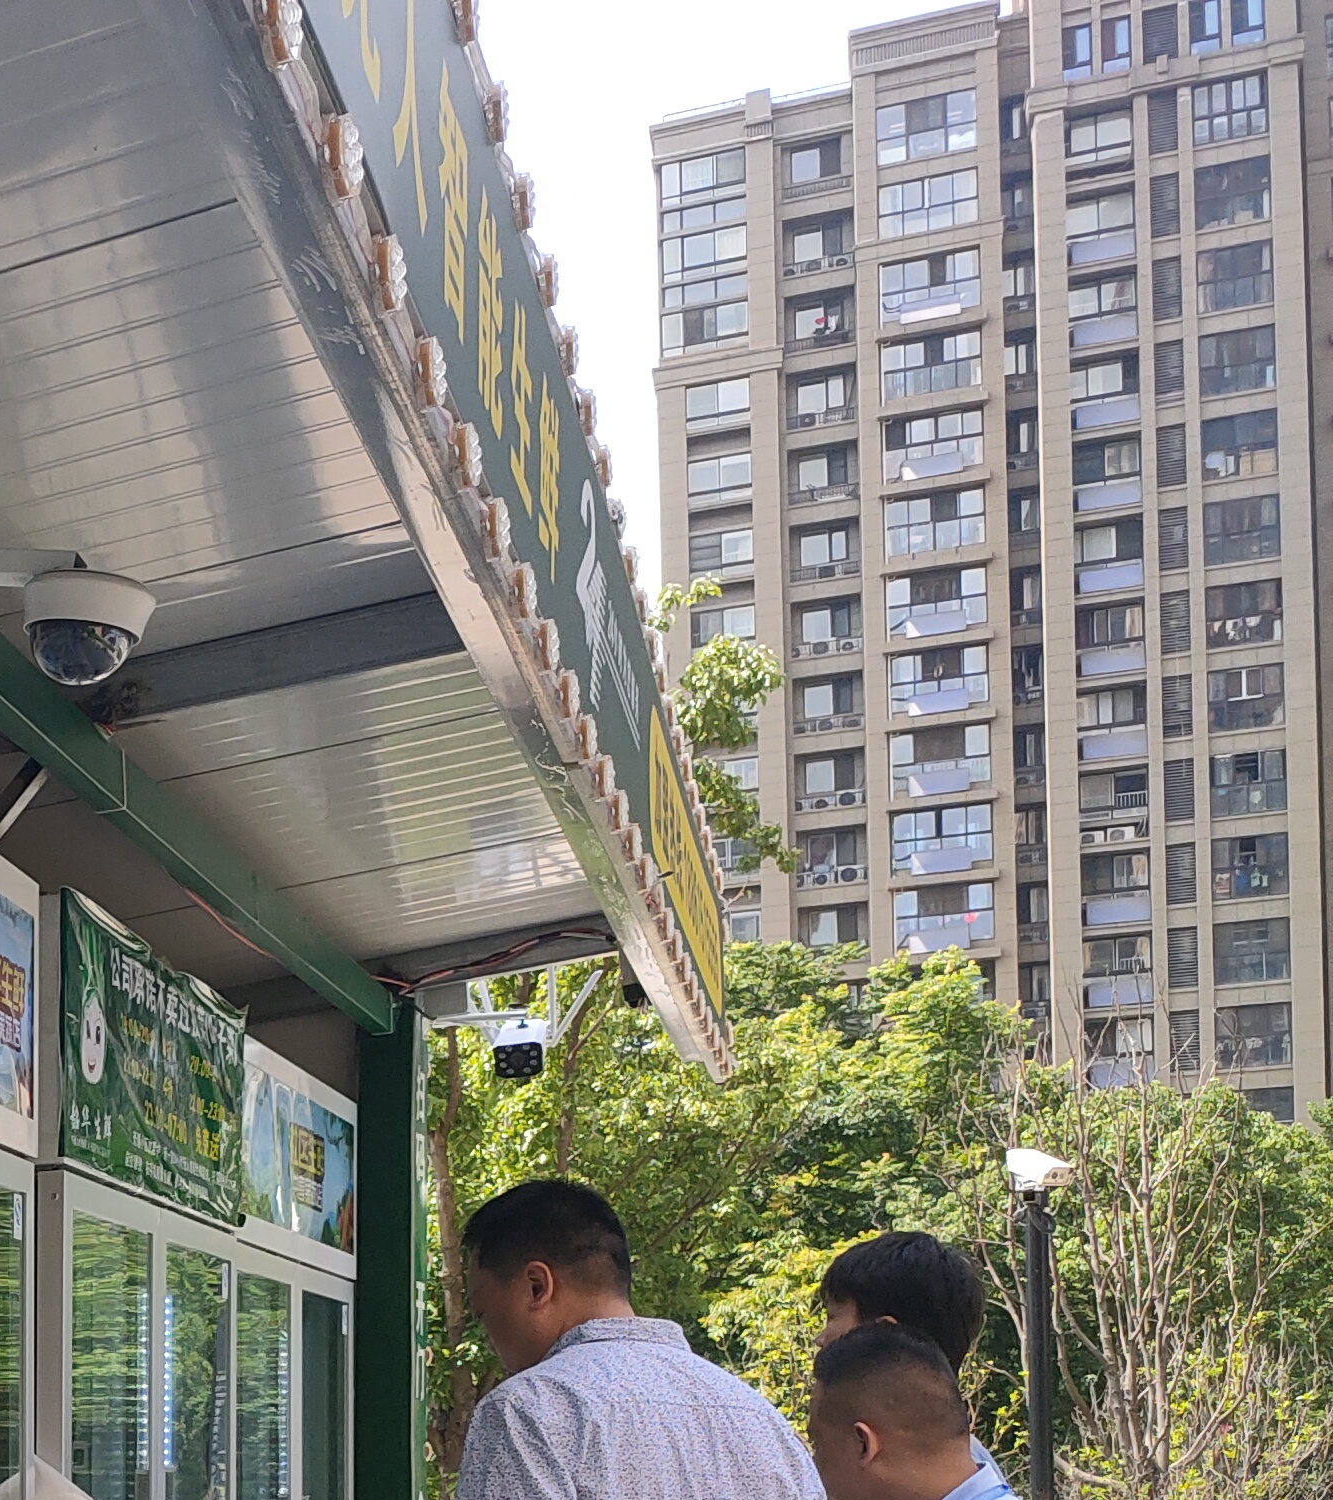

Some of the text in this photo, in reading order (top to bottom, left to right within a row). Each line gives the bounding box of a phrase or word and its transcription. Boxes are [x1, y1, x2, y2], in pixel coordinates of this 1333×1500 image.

[341, 0, 561, 586] 人智能生鲜
